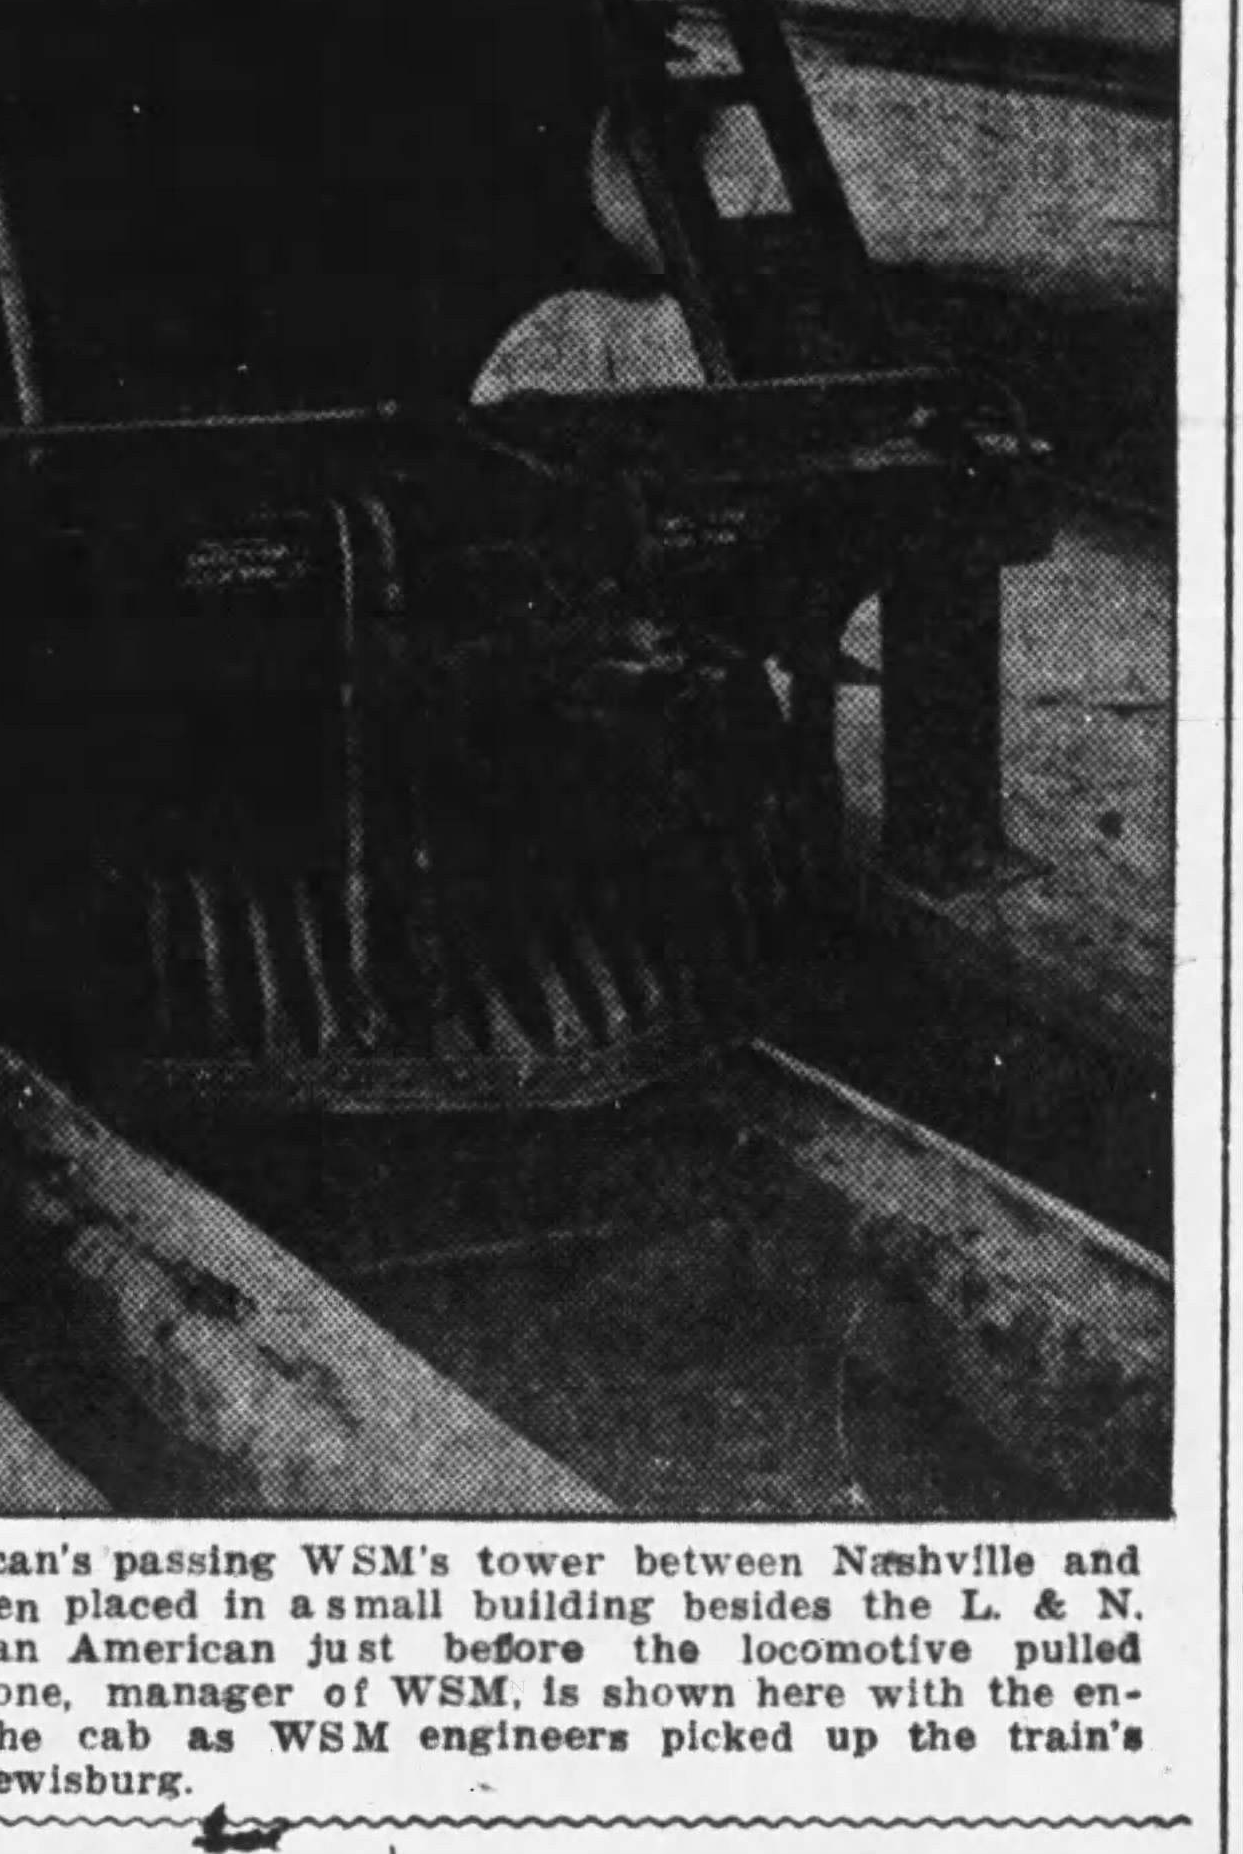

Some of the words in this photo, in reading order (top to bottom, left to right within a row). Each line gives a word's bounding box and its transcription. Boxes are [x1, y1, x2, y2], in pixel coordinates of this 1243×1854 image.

[115, 1545, 275, 1580] passing
[303, 1545, 448, 1575] WSM's
[479, 1548, 604, 1576] tower
[636, 1546, 801, 1576] between
[835, 1545, 1034, 1575] Nashville
[1066, 1545, 1138, 1575] and
[67, 1589, 196, 1624] placed
[226, 1590, 262, 1619] in
[292, 1596, 313, 1618] a
[328, 1589, 440, 1619] small
[475, 1590, 653, 1624] building
[685, 1591, 830, 1620] besides
[866, 1590, 930, 1619] the
[963, 1589, 1000, 1619] L.
[1035, 1589, 1064, 1619] &
[1099, 1588, 1141, 1619] N.
[70, 1634, 273, 1663] American
[308, 1634, 391, 1668] just
[446, 1633, 583, 1663] before
[635, 1634, 698, 1663] the
[744, 1634, 970, 1664] locomotive
[1016, 1632, 1140, 1669] pulled
[108, 1684, 292, 1712] manager
[325, 1678, 367, 1707] of
[392, 1676, 519, 1708] WSM,
[545, 1676, 577, 1705] is
[604, 1677, 733, 1707] shown
[758, 1678, 843, 1707] here
[870, 1678, 961, 1707] with
[990, 1677, 1052, 1706] the
[1075, 1684, 1140, 1706] en-
[80, 1720, 150, 1750] cab
[189, 1727, 233, 1752] as
[271, 1721, 388, 1752] WSM
[420, 1721, 627, 1755] engineers
[663, 1721, 791, 1756] picked
[827, 1728, 877, 1757] up
[909, 1721, 975, 1751] the
[1010, 1720, 1142, 1751] train's
